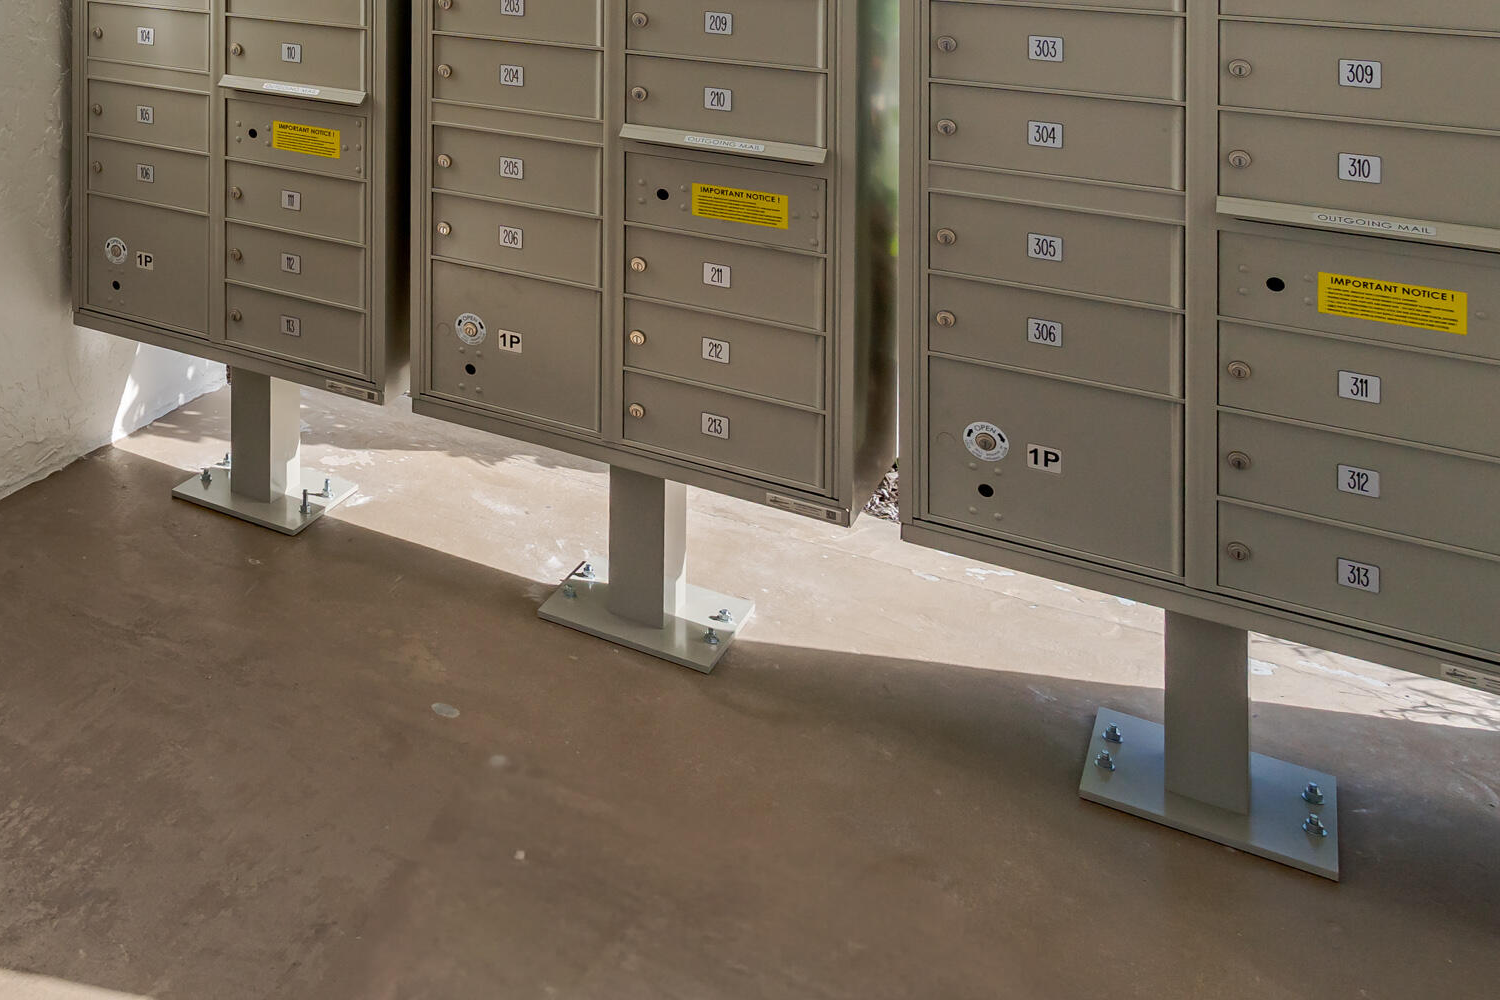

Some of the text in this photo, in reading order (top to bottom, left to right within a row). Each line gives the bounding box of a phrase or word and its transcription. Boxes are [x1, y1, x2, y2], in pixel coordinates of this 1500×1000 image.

[709, 15, 727, 31] 209
[139, 30, 150, 42] 104
[286, 47, 296, 59] 110
[1034, 40, 1057, 58] 303
[504, 68, 519, 83] 204
[1347, 64, 1373, 84] 309
[710, 91, 725, 107] 210
[278, 123, 310, 134] IMPORTANT
[311, 128, 331, 137] NOTICE
[1034, 125, 1056, 143] 304
[687, 135, 761, 151] OUTGOING MAIL
[504, 161, 519, 176] 205
[1348, 158, 1370, 178] 310
[700, 185, 744, 200] IMPORTANT
[746, 192, 776, 203] NOTICE
[1317, 213, 1432, 234] OUTGOING MAIL
[503, 229, 518, 245] 206
[1034, 238, 1056, 257] 305
[137, 254, 153, 267] 1P
[711, 267, 723, 284] 211
[1330, 276, 1399, 295] IMPORTANT
[1401, 286, 1448, 301] NOTICE
[499, 333, 521, 349] 1P
[1034, 323, 1056, 342] 306
[708, 342, 723, 360] 212
[1350, 377, 1368, 397] 311
[708, 417, 723, 434] 213
[974, 424, 997, 434] OPEN
[1029, 448, 1060, 467] 1P
[1348, 470, 1369, 493] 312
[1347, 564, 1370, 587] 313
